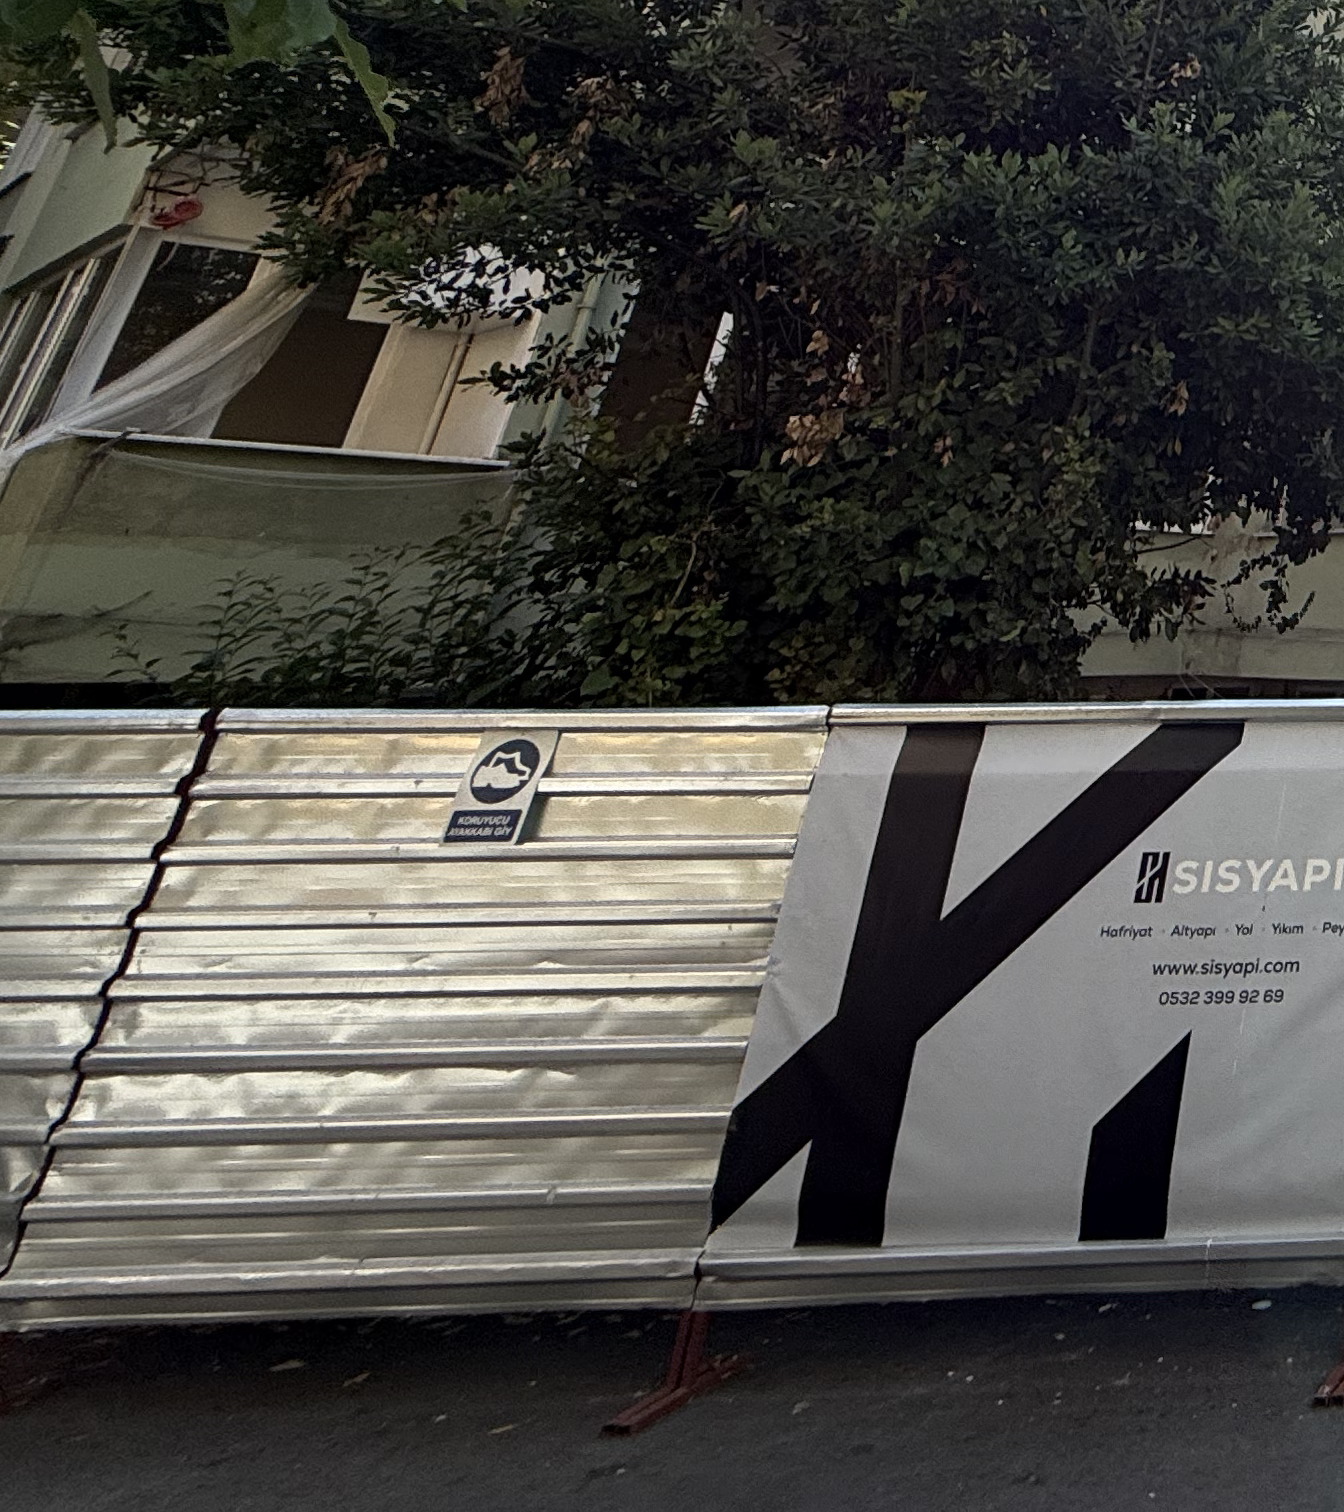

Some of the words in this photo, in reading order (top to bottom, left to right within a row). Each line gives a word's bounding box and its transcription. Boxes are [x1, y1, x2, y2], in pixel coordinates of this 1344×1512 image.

[457, 815, 511, 825] KORUYUCU
[494, 825, 513, 836] GİY
[1100, 926, 1153, 941] Hafriyat
[1171, 924, 1216, 939] Altyapı
[1235, 923, 1254, 936] Yol
[1152, 958, 1300, 979] www.sisyapi.com
[1159, 991, 1200, 1006] 0532
[1203, 990, 1235, 1005] 399
[1238, 989, 1260, 1004] 92
[1263, 989, 1285, 1004] 69
